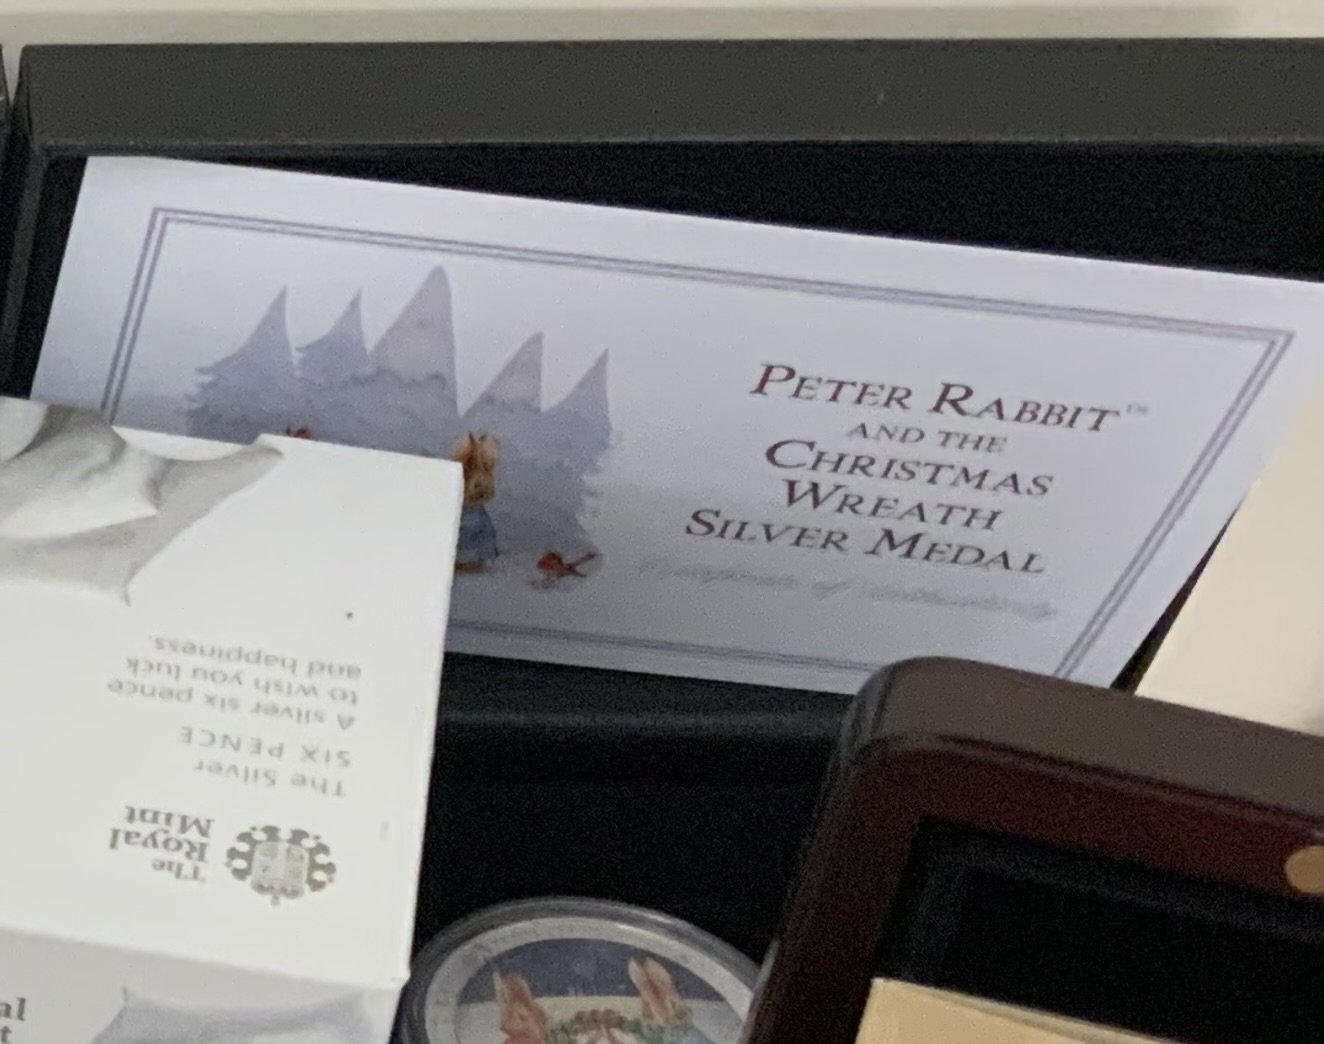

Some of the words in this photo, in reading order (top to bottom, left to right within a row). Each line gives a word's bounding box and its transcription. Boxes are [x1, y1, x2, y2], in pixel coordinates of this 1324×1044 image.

[748, 363, 913, 410] PETER
[846, 421, 926, 445] AND
[936, 430, 1009, 454] THE
[763, 438, 1055, 498] CHRISTMAS
[780, 478, 1004, 533] WREATH
[684, 508, 851, 553] SILVER
[863, 527, 1047, 576] MEDAL
[126, 657, 181, 681] luck
[191, 666, 244, 686] you
[306, 660, 362, 681] and
[107, 677, 195, 704] pence
[253, 677, 319, 698] wish
[329, 687, 359, 706] to
[204, 693, 241, 712] six
[250, 701, 326, 725] silver
[336, 713, 356, 731] A
[179, 725, 286, 760] PENCE
[300, 744, 351, 768] SIX
[193, 759, 277, 787] Silver
[290, 772, 347, 798] The
[124, 804, 216, 839] Mint
[108, 828, 210, 863] Royal
[151, 857, 207, 884] The
